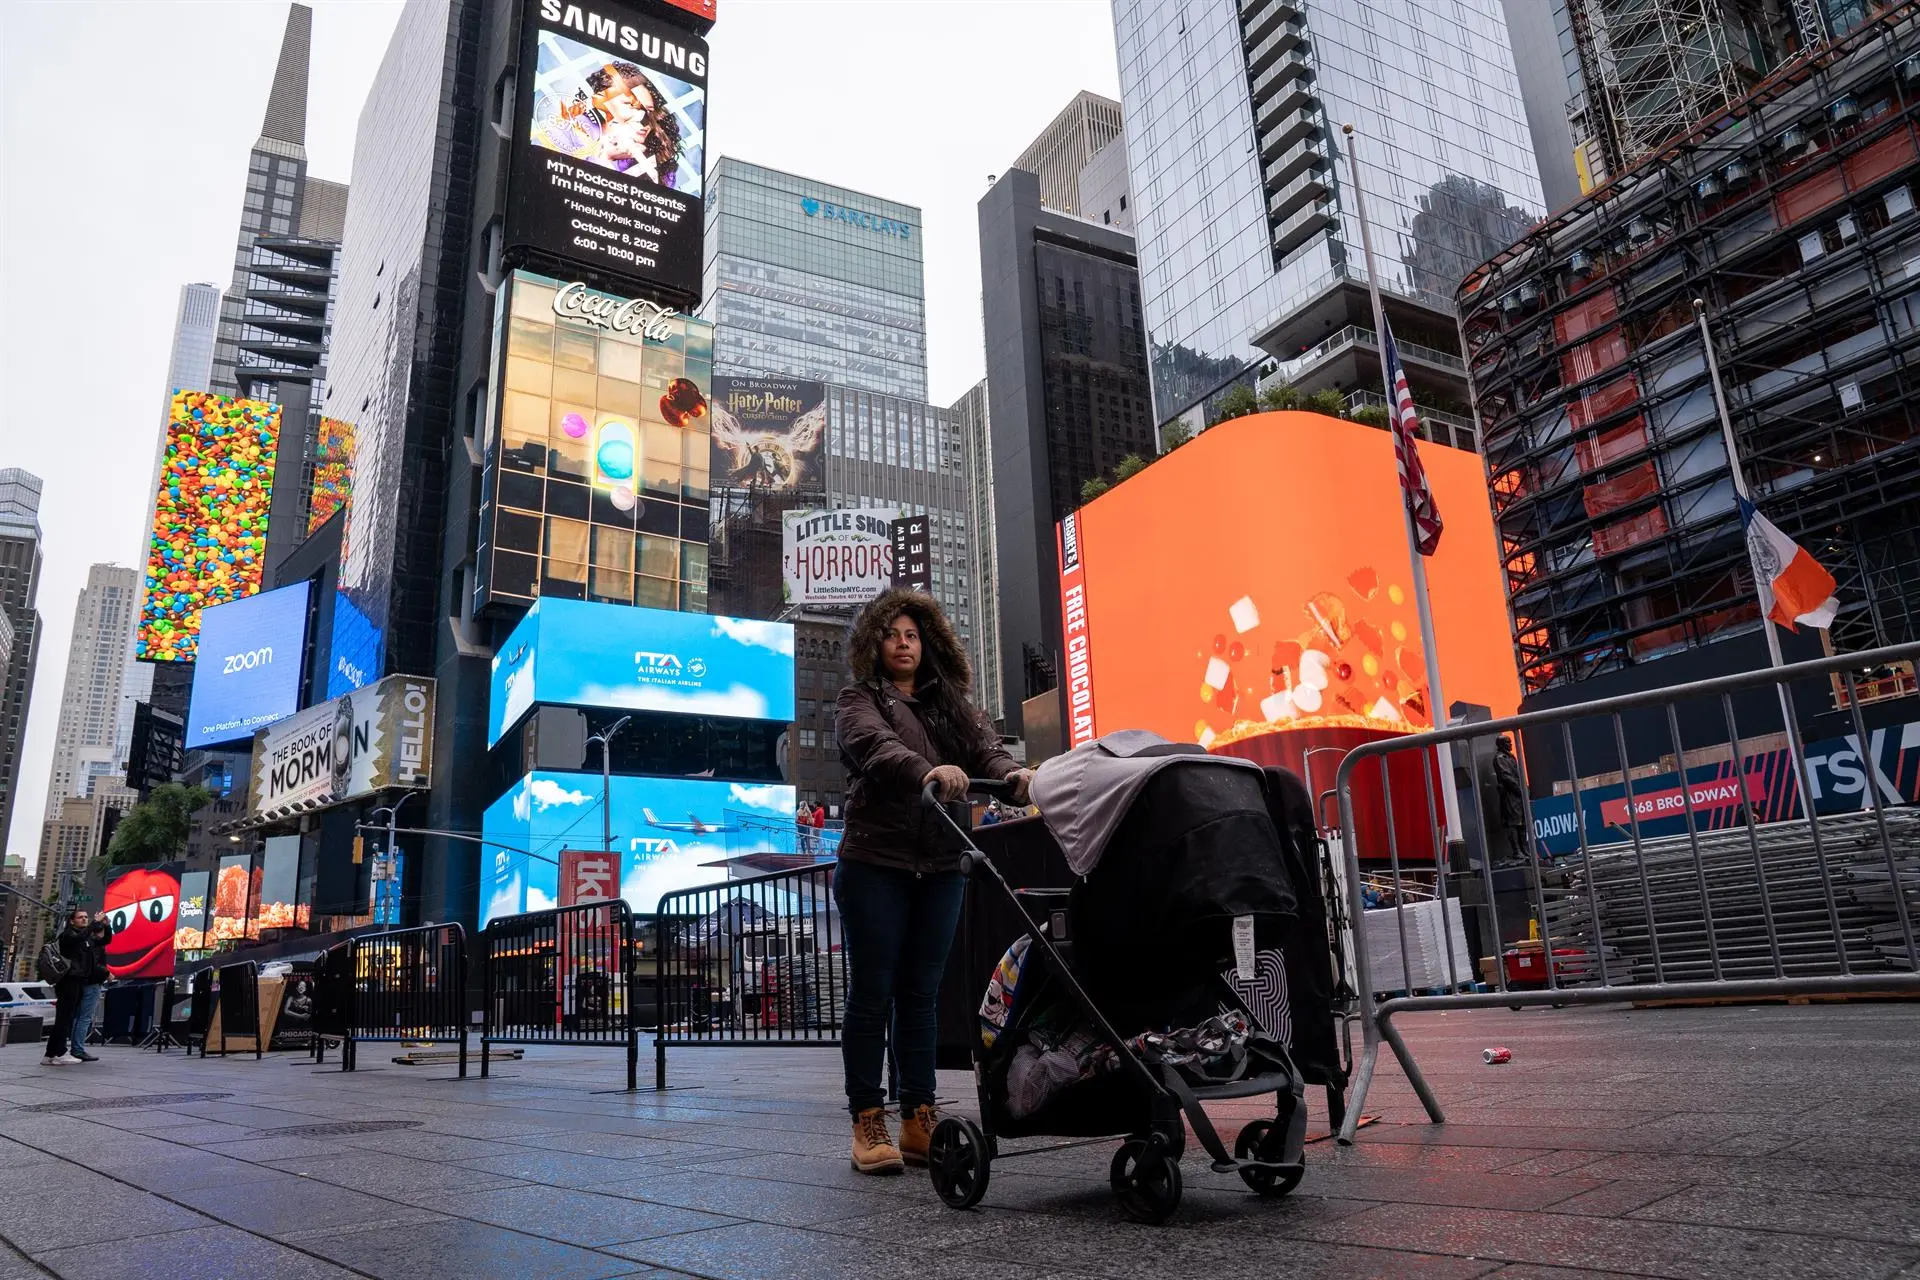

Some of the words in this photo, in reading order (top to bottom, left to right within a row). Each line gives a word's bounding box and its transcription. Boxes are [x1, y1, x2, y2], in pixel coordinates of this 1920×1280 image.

[540, 0, 706, 76] SAMSUNG
[547, 160, 574, 176] MTY
[576, 169, 628, 193] Podcast
[630, 186, 686, 212] Presents:
[552, 174, 571, 190] I'm
[574, 181, 604, 199] Here
[606, 191, 628, 206] For
[630, 198, 652, 214] You
[654, 206, 681, 223] Tour
[571, 219, 620, 240] October
[622, 234, 632, 246] 8,
[634, 238, 659, 252] 2022
[824, 204, 910, 238] BARCLAYS
[573, 236, 597, 250] 6:00
[607, 245, 634, 261] 10:00
[636, 254, 656, 268] pm
[750, 381, 798, 390] BROADWAY
[727, 392, 764, 414] Harry
[764, 392, 802, 414] Potter
[796, 514, 852, 542] LITTLE
[1064, 513, 1078, 563] ERSHEY'S
[1065, 584, 1085, 634] FREE
[224, 646, 272, 674] zoom
[635, 651, 683, 668] ITA
[638, 665, 680, 676] AIRWAYS
[1068, 634, 1095, 748] CHOCOLAT
[203, 725, 215, 734] One
[252, 713, 279, 724] Connect
[399, 683, 426, 781] HELLO!
[272, 746, 289, 765] THE
[291, 732, 317, 756] BOOK
[319, 723, 332, 740] OF
[1799, 728, 1906, 809] TSX
[1657, 784, 1739, 811] BROADWAY
[631, 838, 680, 855] ITA
